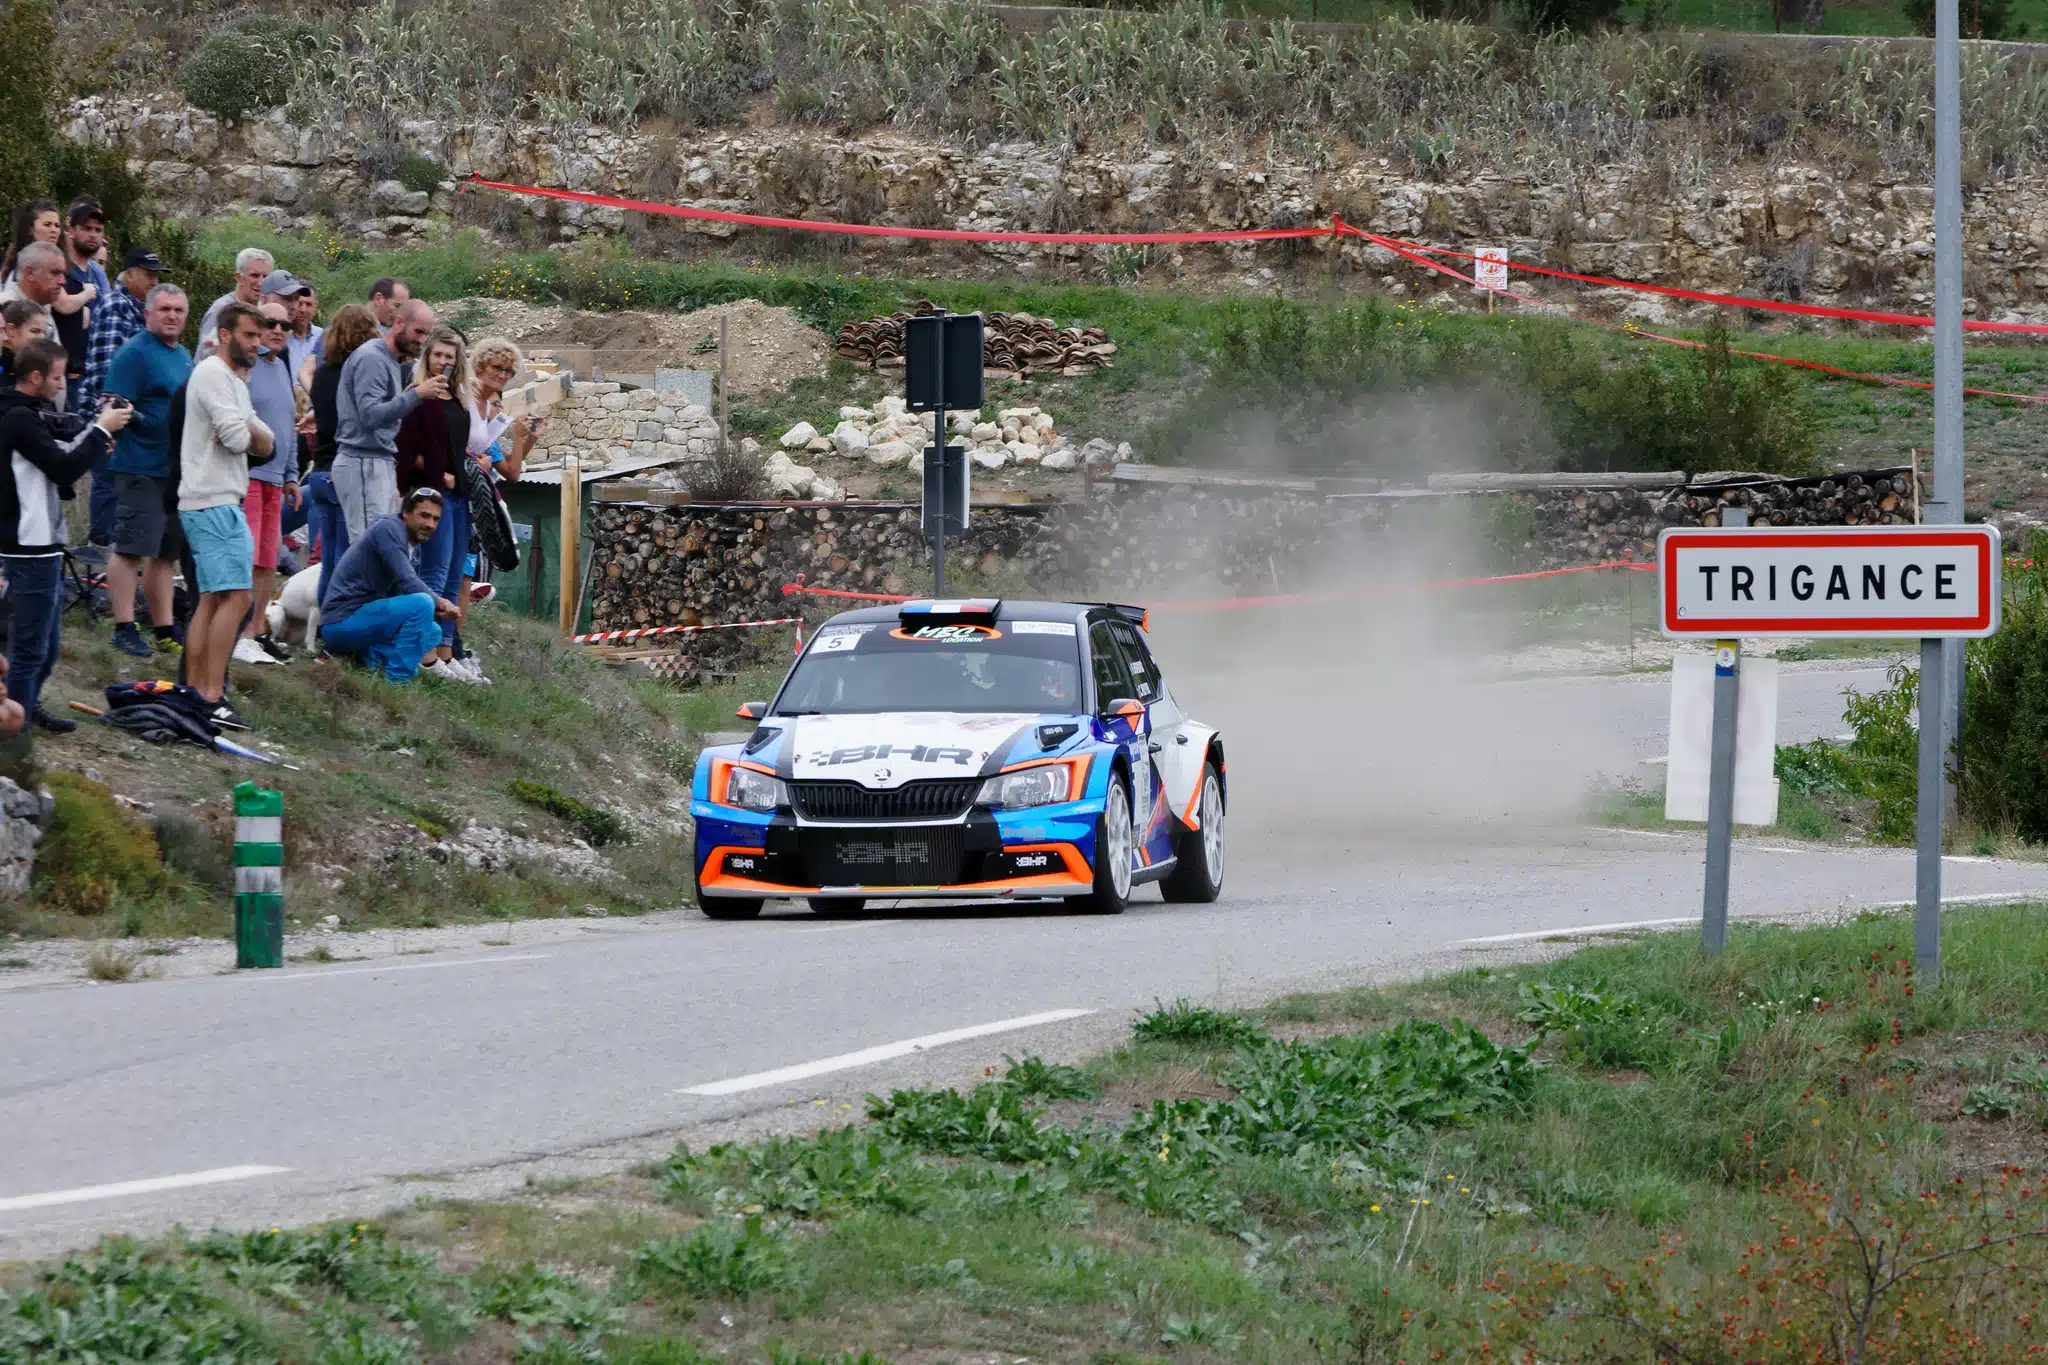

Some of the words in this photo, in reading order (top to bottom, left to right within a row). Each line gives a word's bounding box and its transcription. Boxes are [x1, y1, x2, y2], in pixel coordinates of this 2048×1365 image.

[1698, 564, 1957, 601] TRIGANCE
[913, 626, 976, 638] MBC
[828, 637, 844, 649] 5
[1044, 727, 1063, 735] BHR
[822, 744, 973, 766] BHR
[733, 859, 754, 869] BHR
[1019, 856, 1047, 866] BHR
